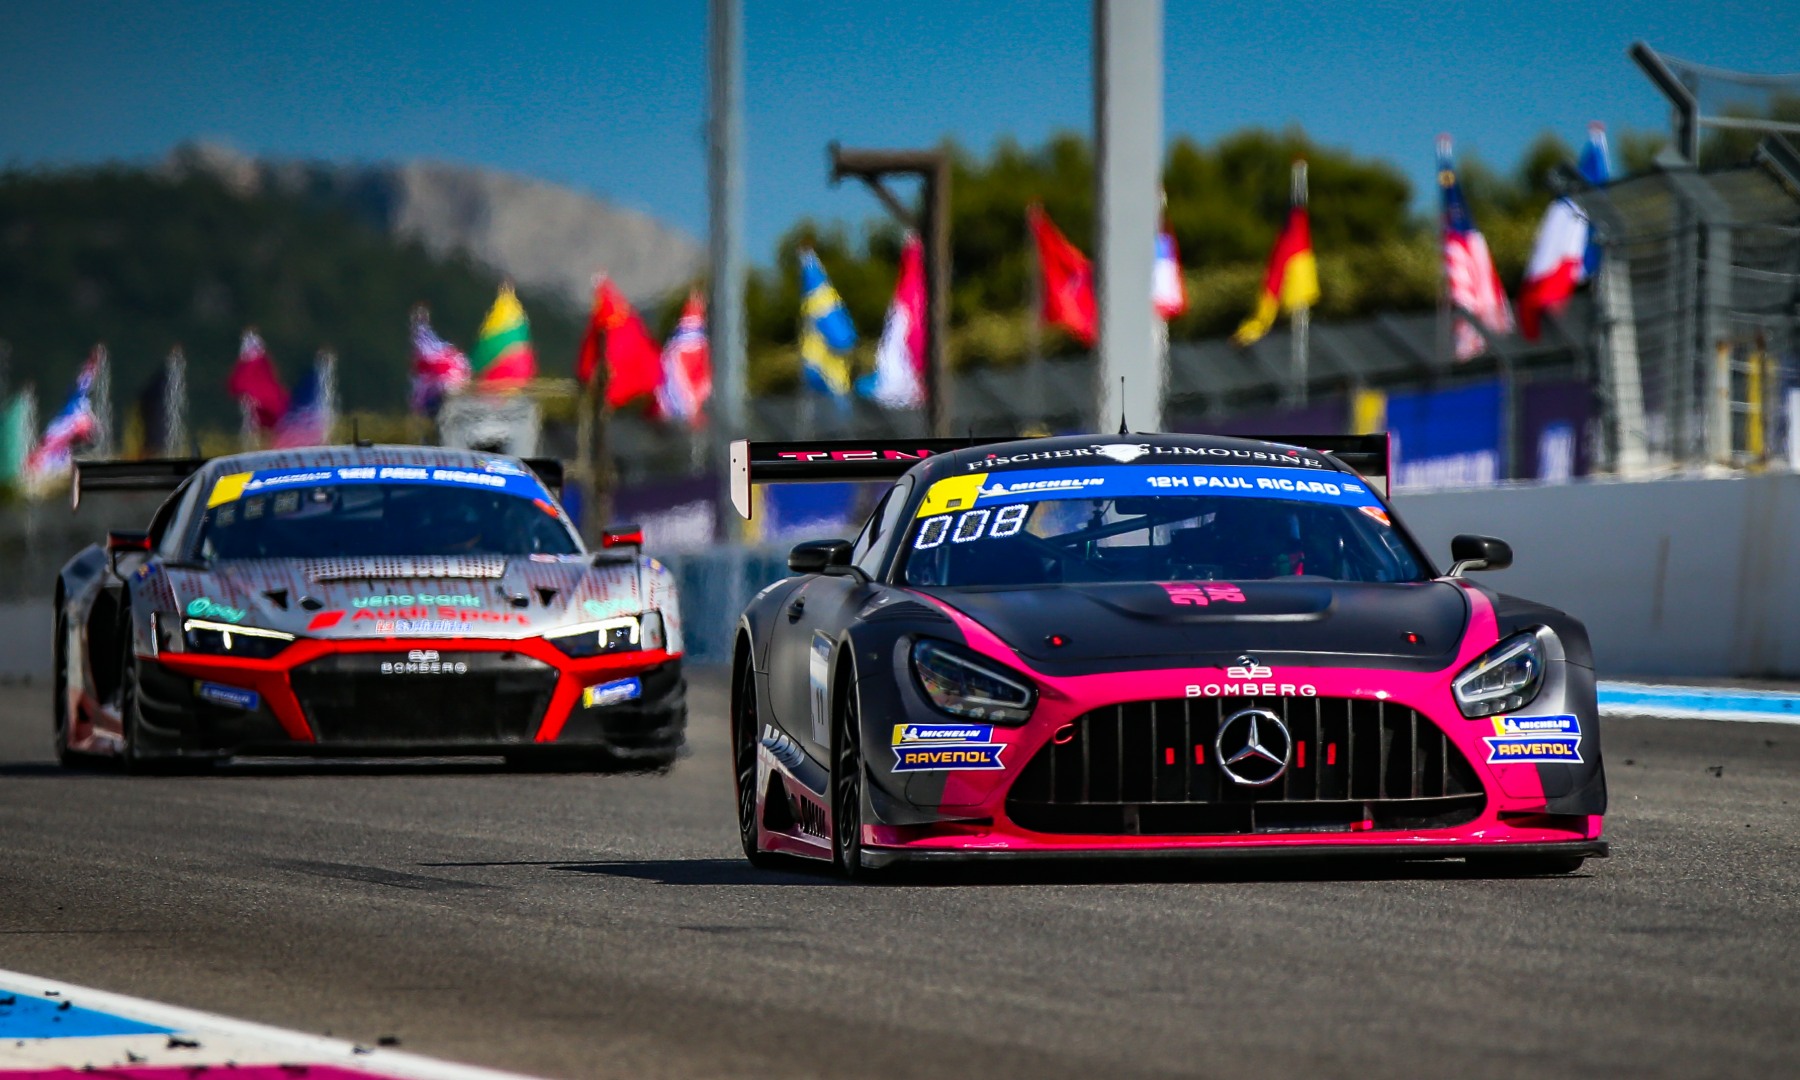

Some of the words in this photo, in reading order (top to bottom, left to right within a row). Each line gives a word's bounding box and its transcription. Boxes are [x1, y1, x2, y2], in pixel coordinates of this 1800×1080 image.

[967, 448, 1093, 471] FISCHER
[1154, 446, 1323, 468] LIMOUSINE
[380, 467, 429, 480] PAUL
[433, 469, 507, 487] RICARD
[1010, 477, 1105, 492] MICHELIN
[1147, 476, 1189, 488] 12H
[1193, 476, 1254, 489] PAUL
[1256, 478, 1341, 496] RICARD
[351, 606, 428, 621] Audi
[436, 606, 532, 628] Sport
[1185, 683, 1317, 697] BOMBERG
[1519, 720, 1571, 729] MICHELIN
[919, 730, 981, 738] MICHELIN
[1498, 743, 1573, 755] RAVENOL
[905, 751, 991, 764] RAVENOL
